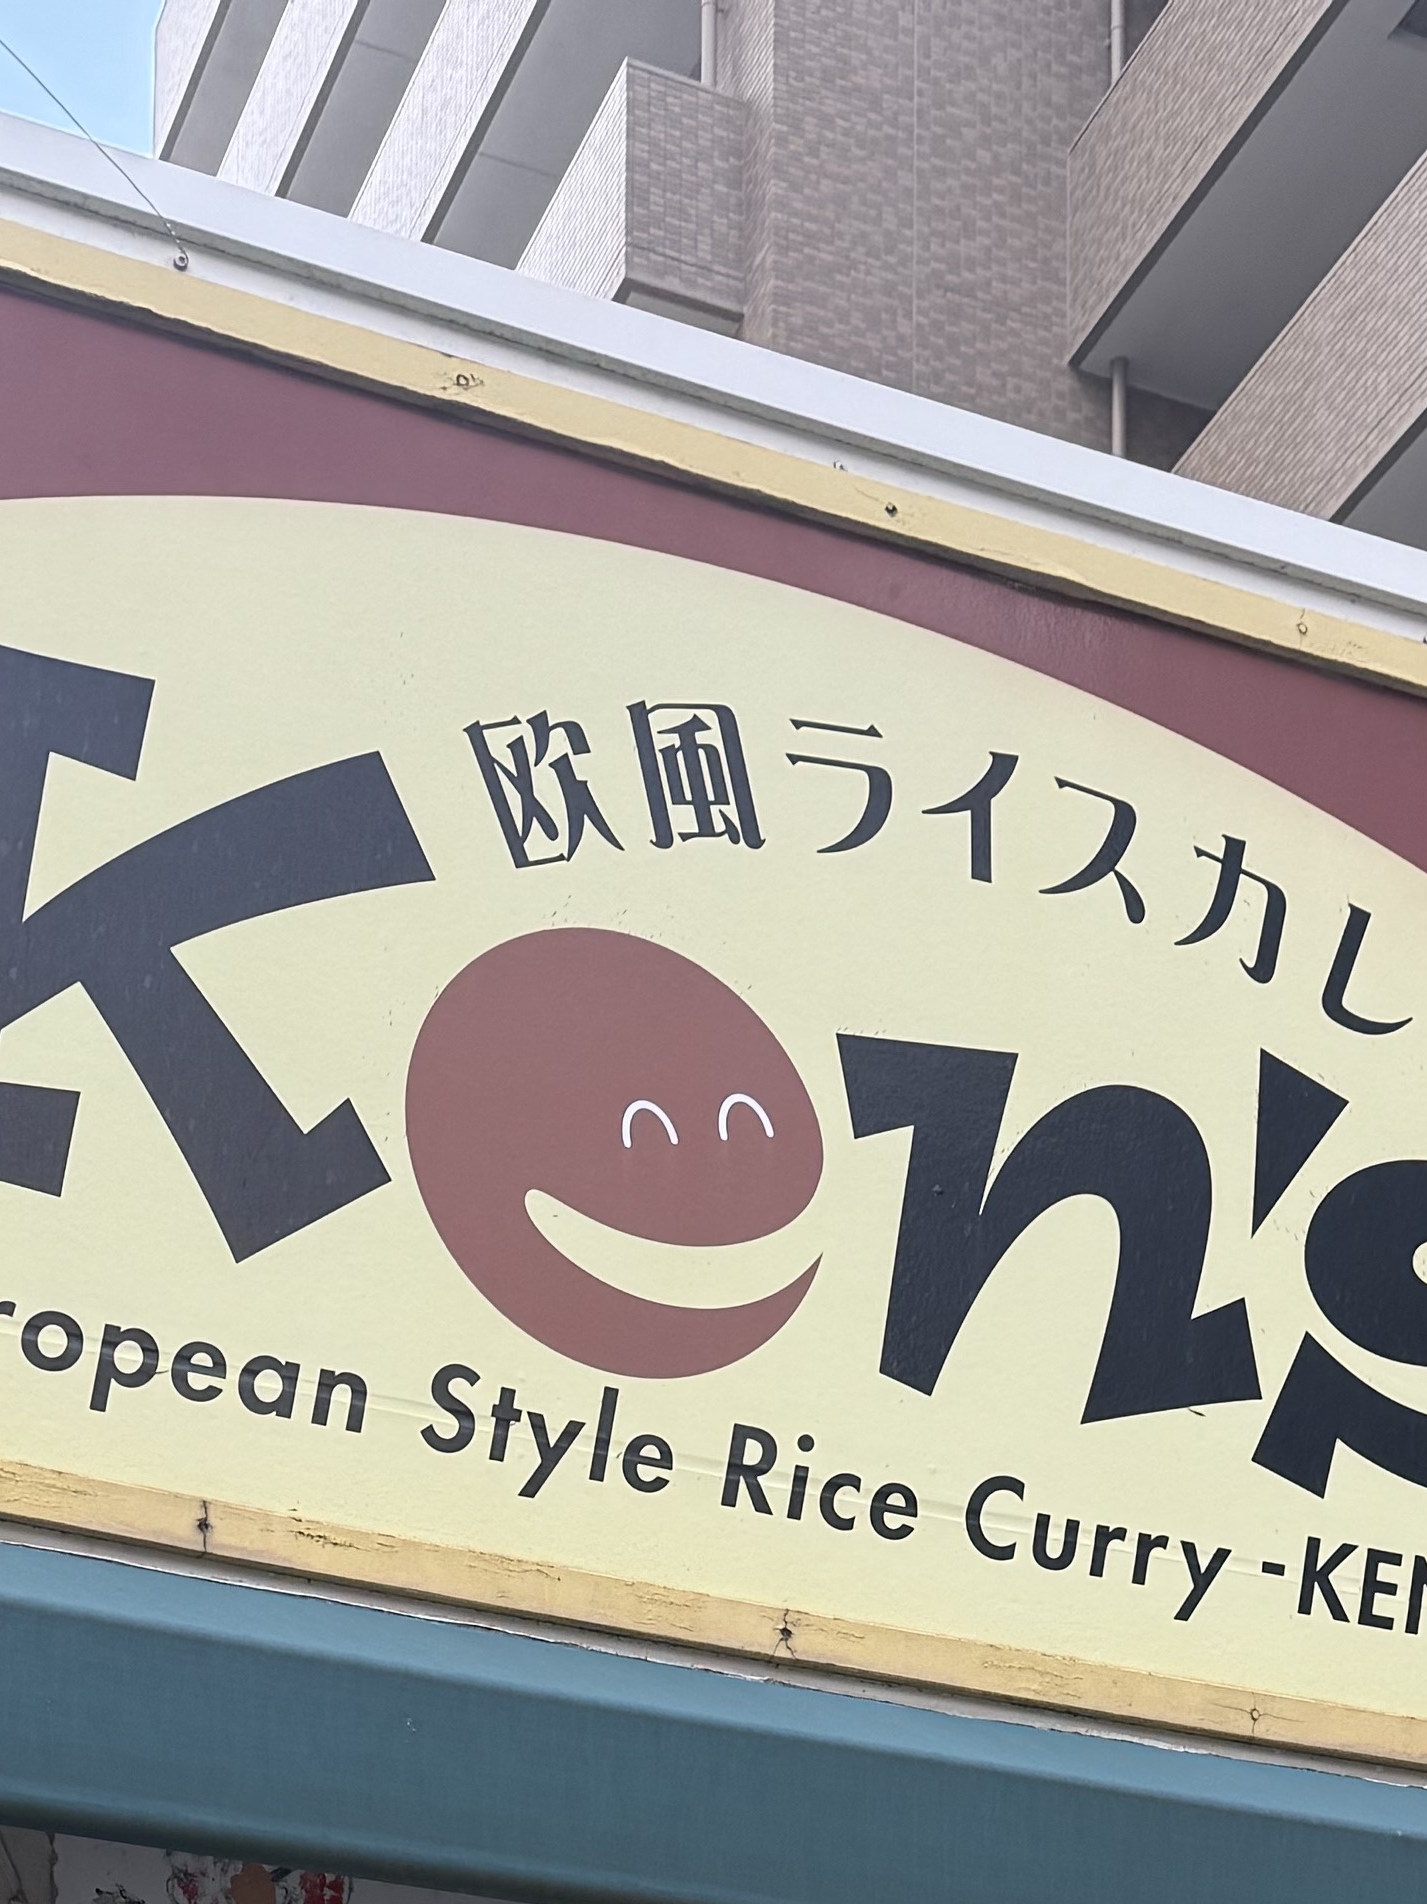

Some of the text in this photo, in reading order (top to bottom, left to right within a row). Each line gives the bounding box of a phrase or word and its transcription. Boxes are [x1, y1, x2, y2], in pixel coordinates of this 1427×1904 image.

[422, 1362, 674, 1500] Style
[724, 1425, 919, 1541] Rice
[963, 1477, 1233, 1622] Curry
